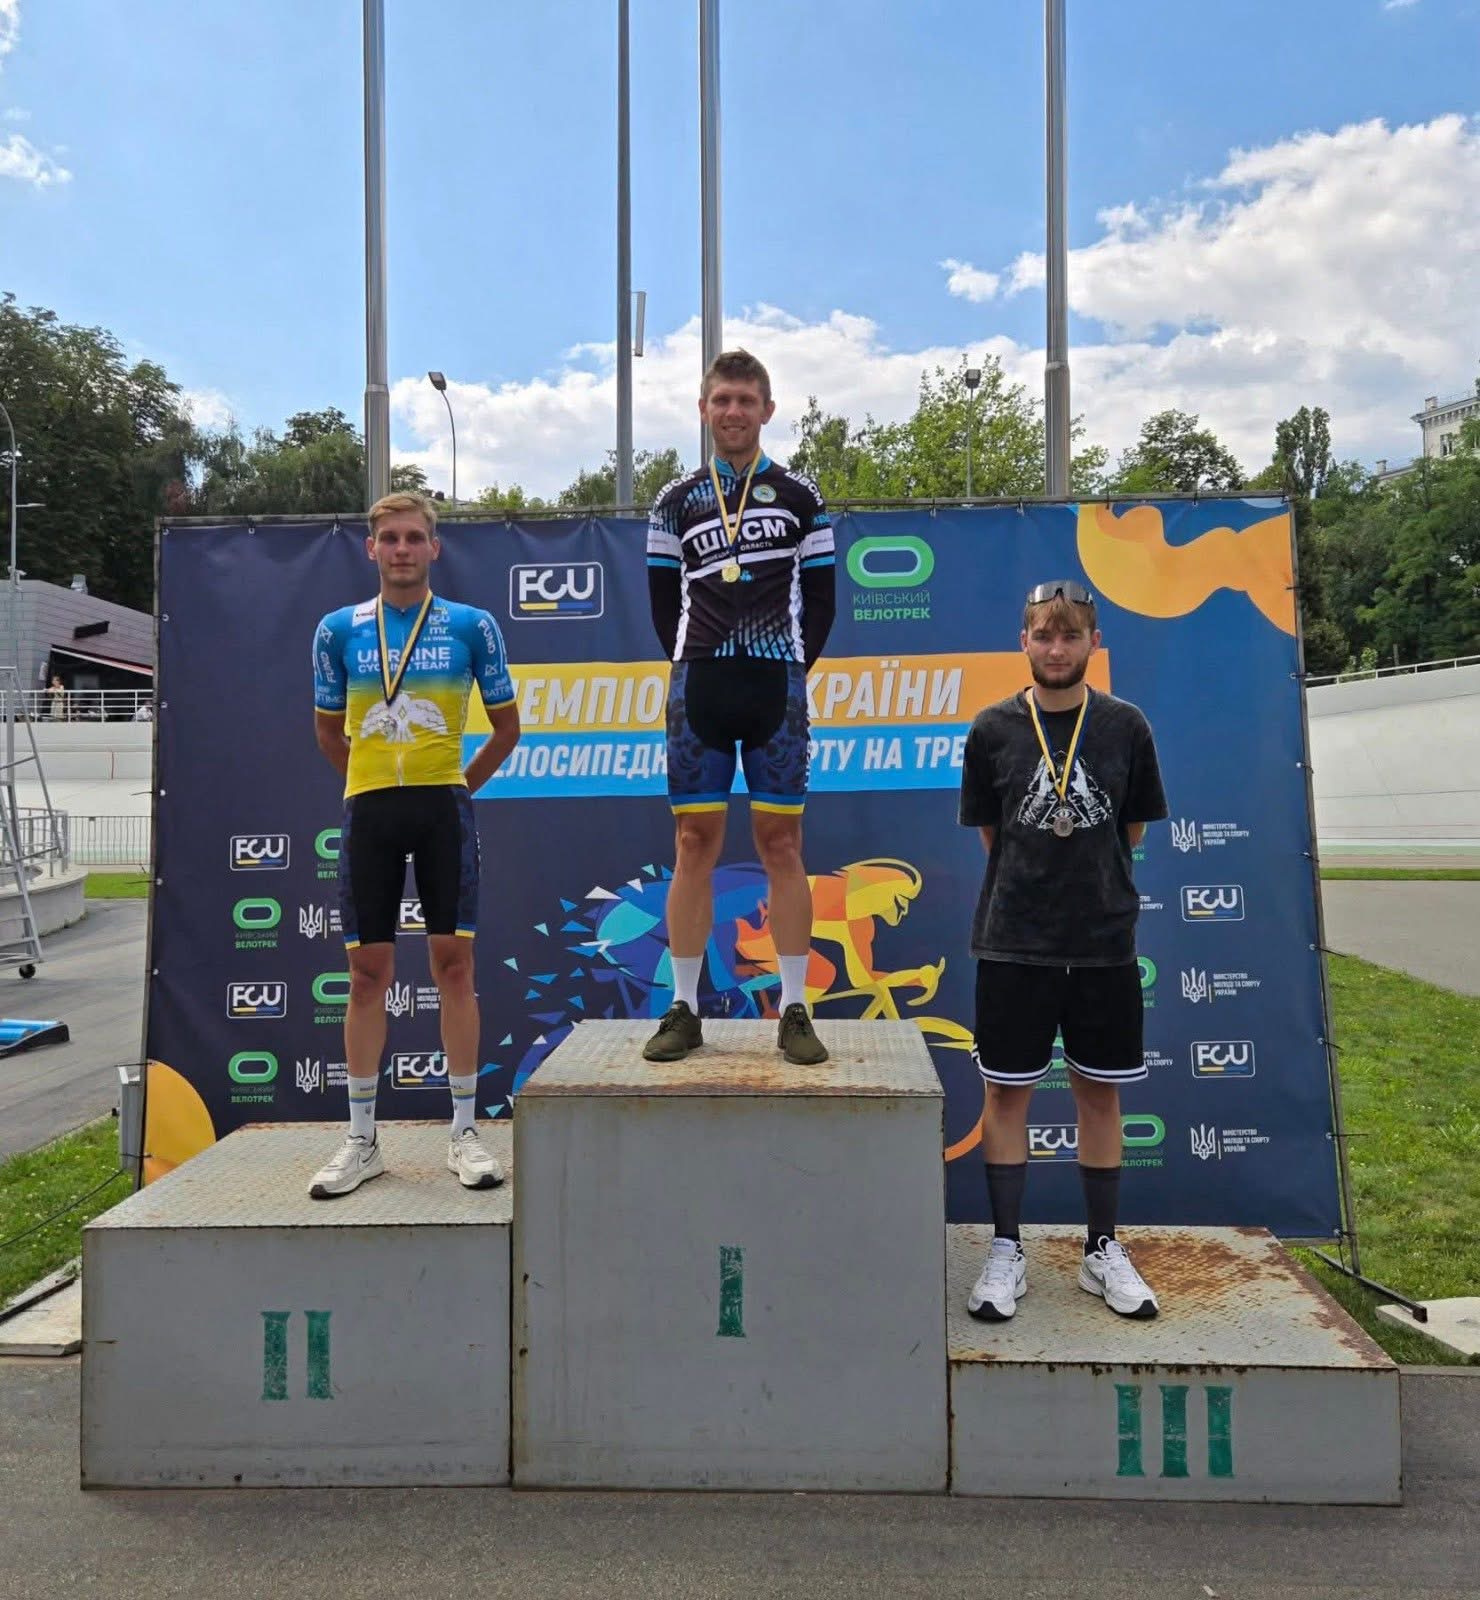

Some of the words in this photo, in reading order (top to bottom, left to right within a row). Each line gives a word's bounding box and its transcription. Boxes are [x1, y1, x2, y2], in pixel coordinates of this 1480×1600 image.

[692, 518, 787, 558] ШСМ
[519, 567, 595, 602] FCU
[853, 607, 932, 621] ВЕЛОТРЕК
[477, 618, 497, 655] FUND
[414, 660, 450, 671] TEAM
[513, 674, 666, 727] ЕМПІО
[806, 659, 963, 719] КРАЇНИ
[806, 738, 856, 773] РТУ
[862, 737, 903, 770] НА
[914, 735, 968, 768] ТРЕ
[234, 838, 284, 860] FCU
[1187, 888, 1238, 912] FCU
[400, 902, 426, 923] FC
[232, 984, 283, 1007] FCU
[397, 1054, 449, 1078] FCU
[1196, 1043, 1248, 1066] FCU
[1028, 1127, 1079, 1151] FCU
[715, 1246, 746, 1338] I
[262, 1311, 333, 1400] II
[1115, 1384, 1234, 1478] III
